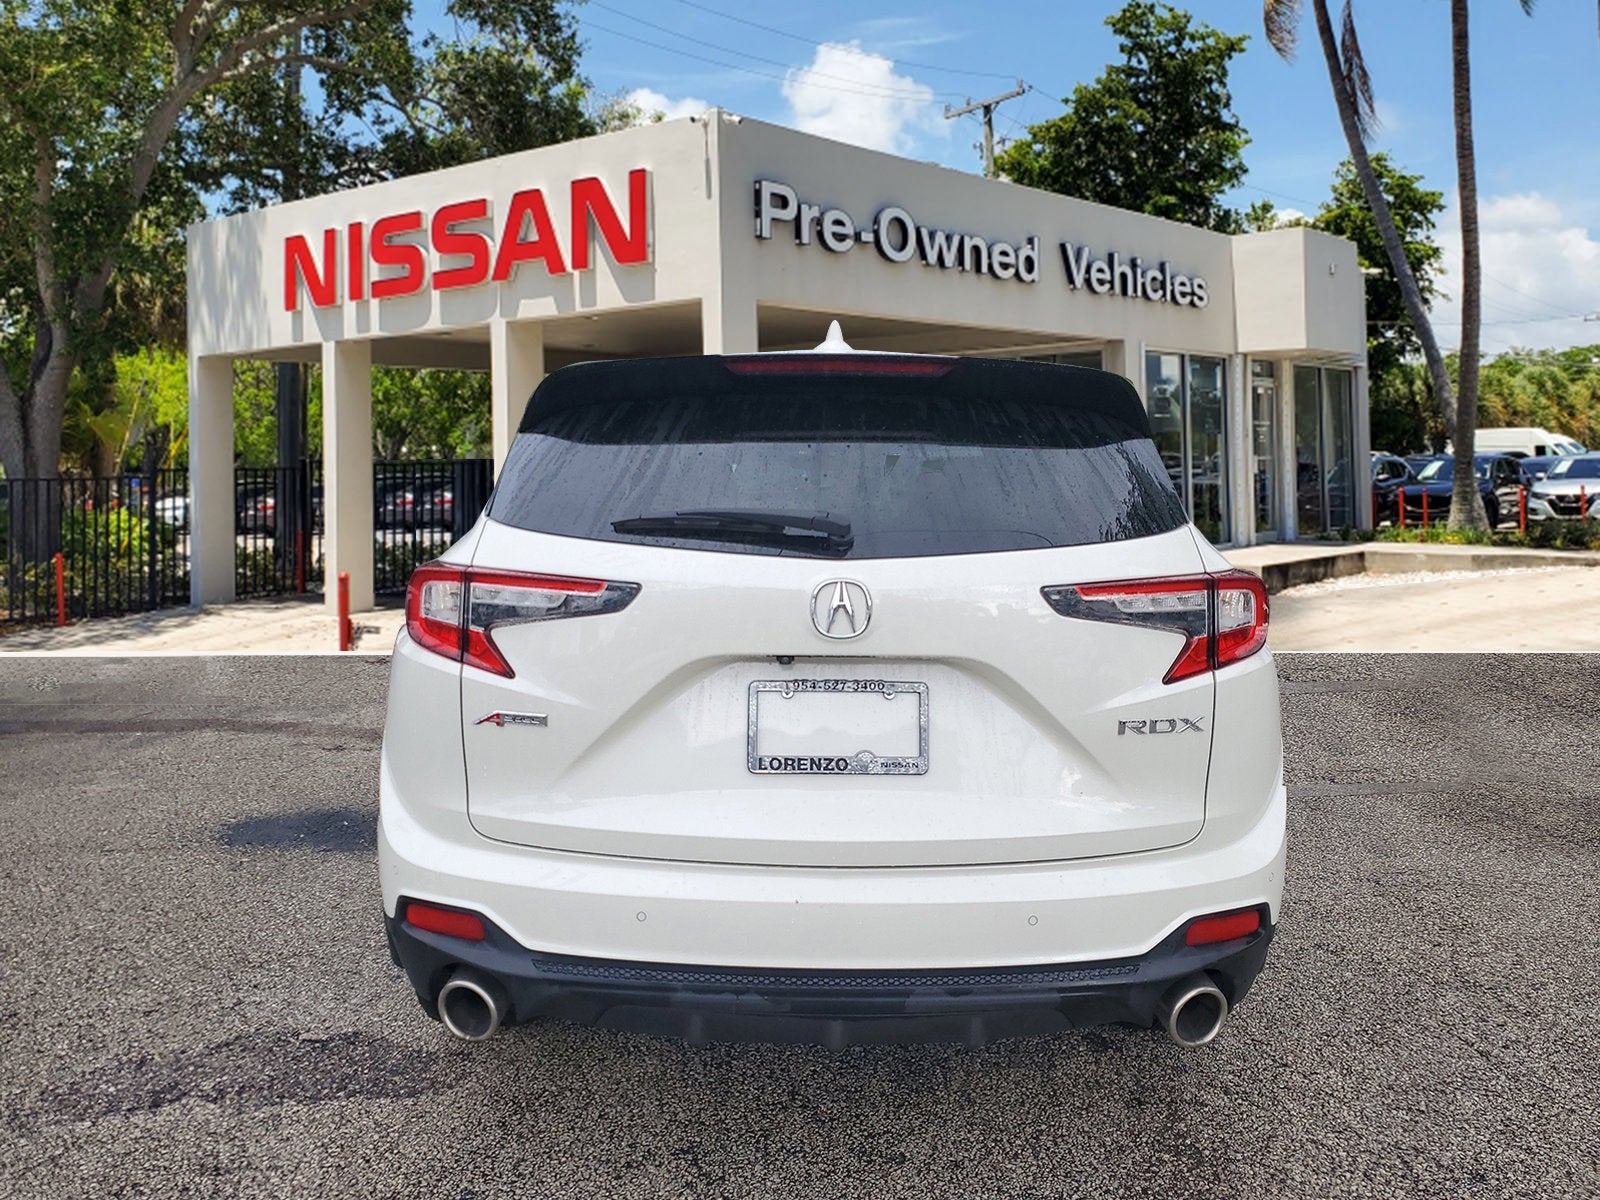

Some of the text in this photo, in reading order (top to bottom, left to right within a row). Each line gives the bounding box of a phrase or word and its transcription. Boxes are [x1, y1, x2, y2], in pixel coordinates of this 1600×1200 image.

[284, 168, 648, 312] NISSAN
[754, 180, 1209, 308] Pre-Owned Vehicles
[792, 681, 885, 691] 954-527-3400
[1117, 716, 1205, 736] RDX
[757, 757, 919, 771] LORENZO NISSAN
